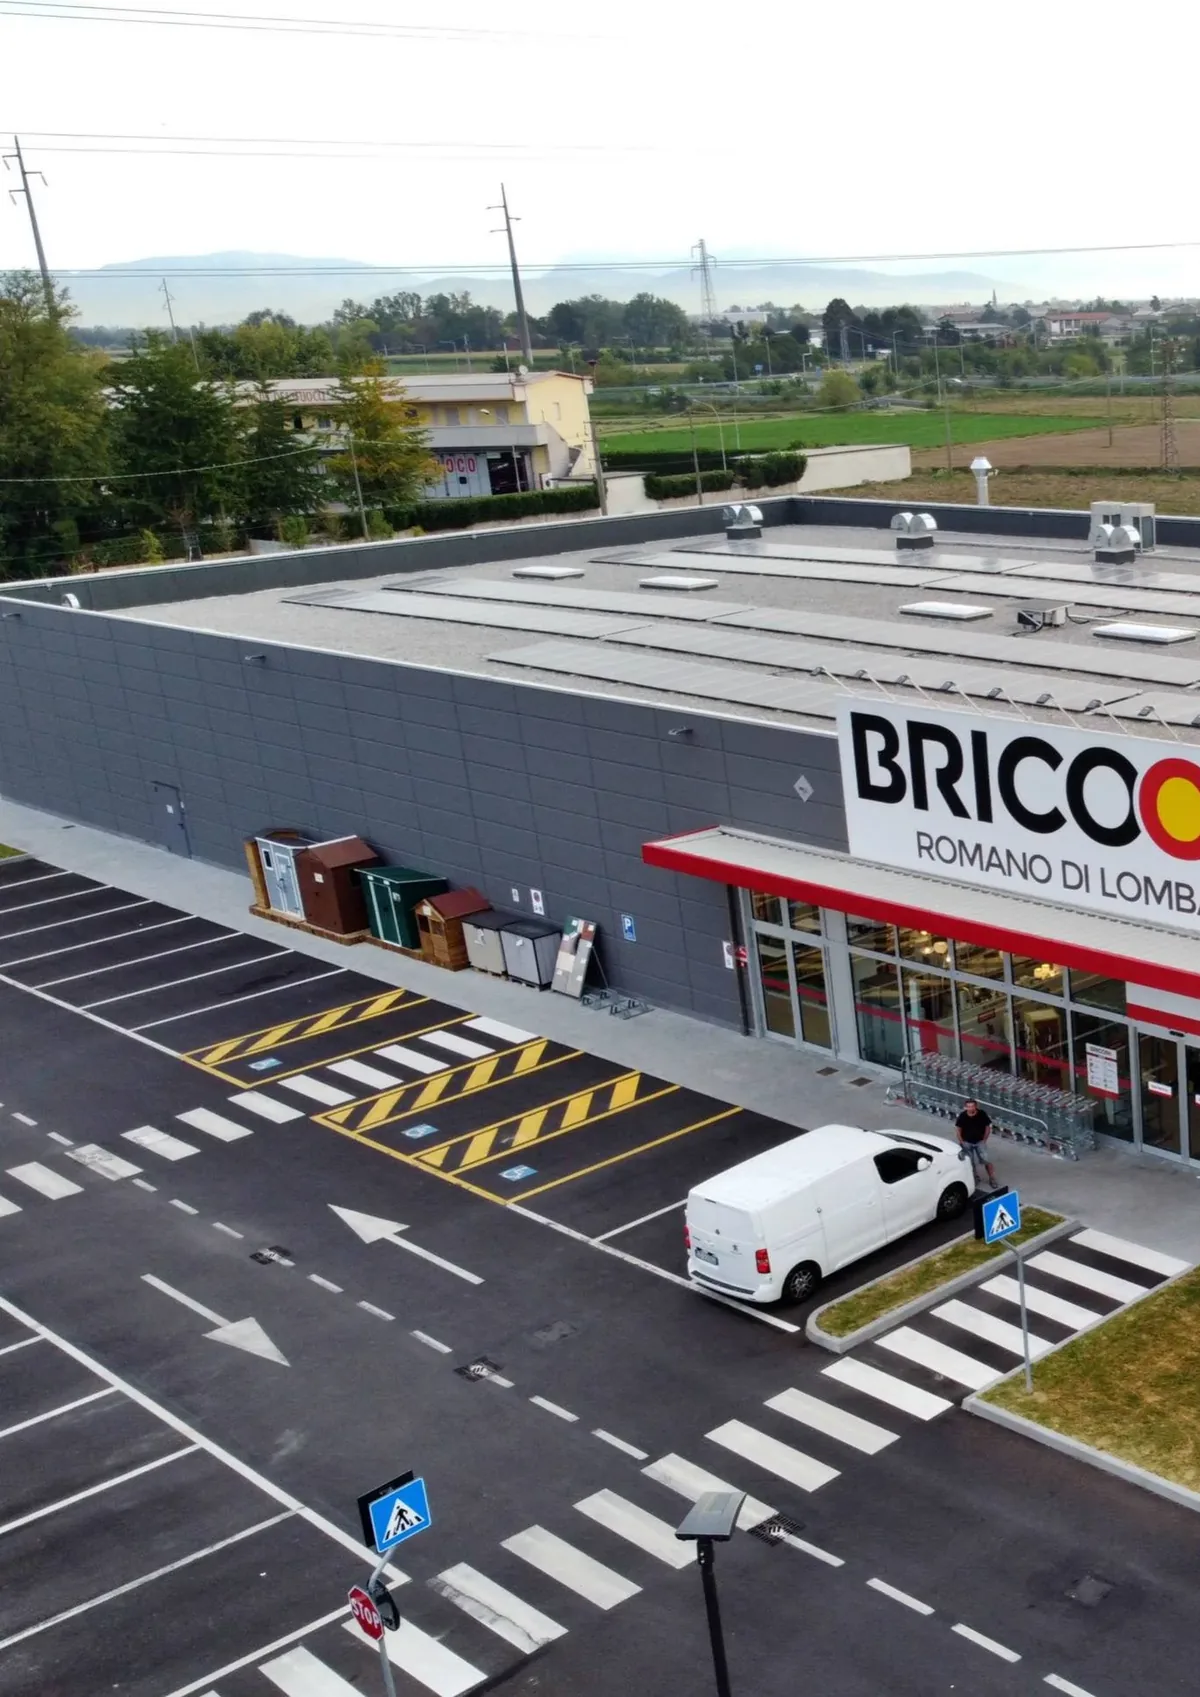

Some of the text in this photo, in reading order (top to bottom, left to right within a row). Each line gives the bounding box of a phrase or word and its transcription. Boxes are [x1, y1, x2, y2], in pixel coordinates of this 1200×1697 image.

[445, 457, 476, 473] OCO
[917, 831, 1053, 884] ROMANO
[1062, 859, 1091, 893] DI
[351, 1598, 380, 1629] STOP
